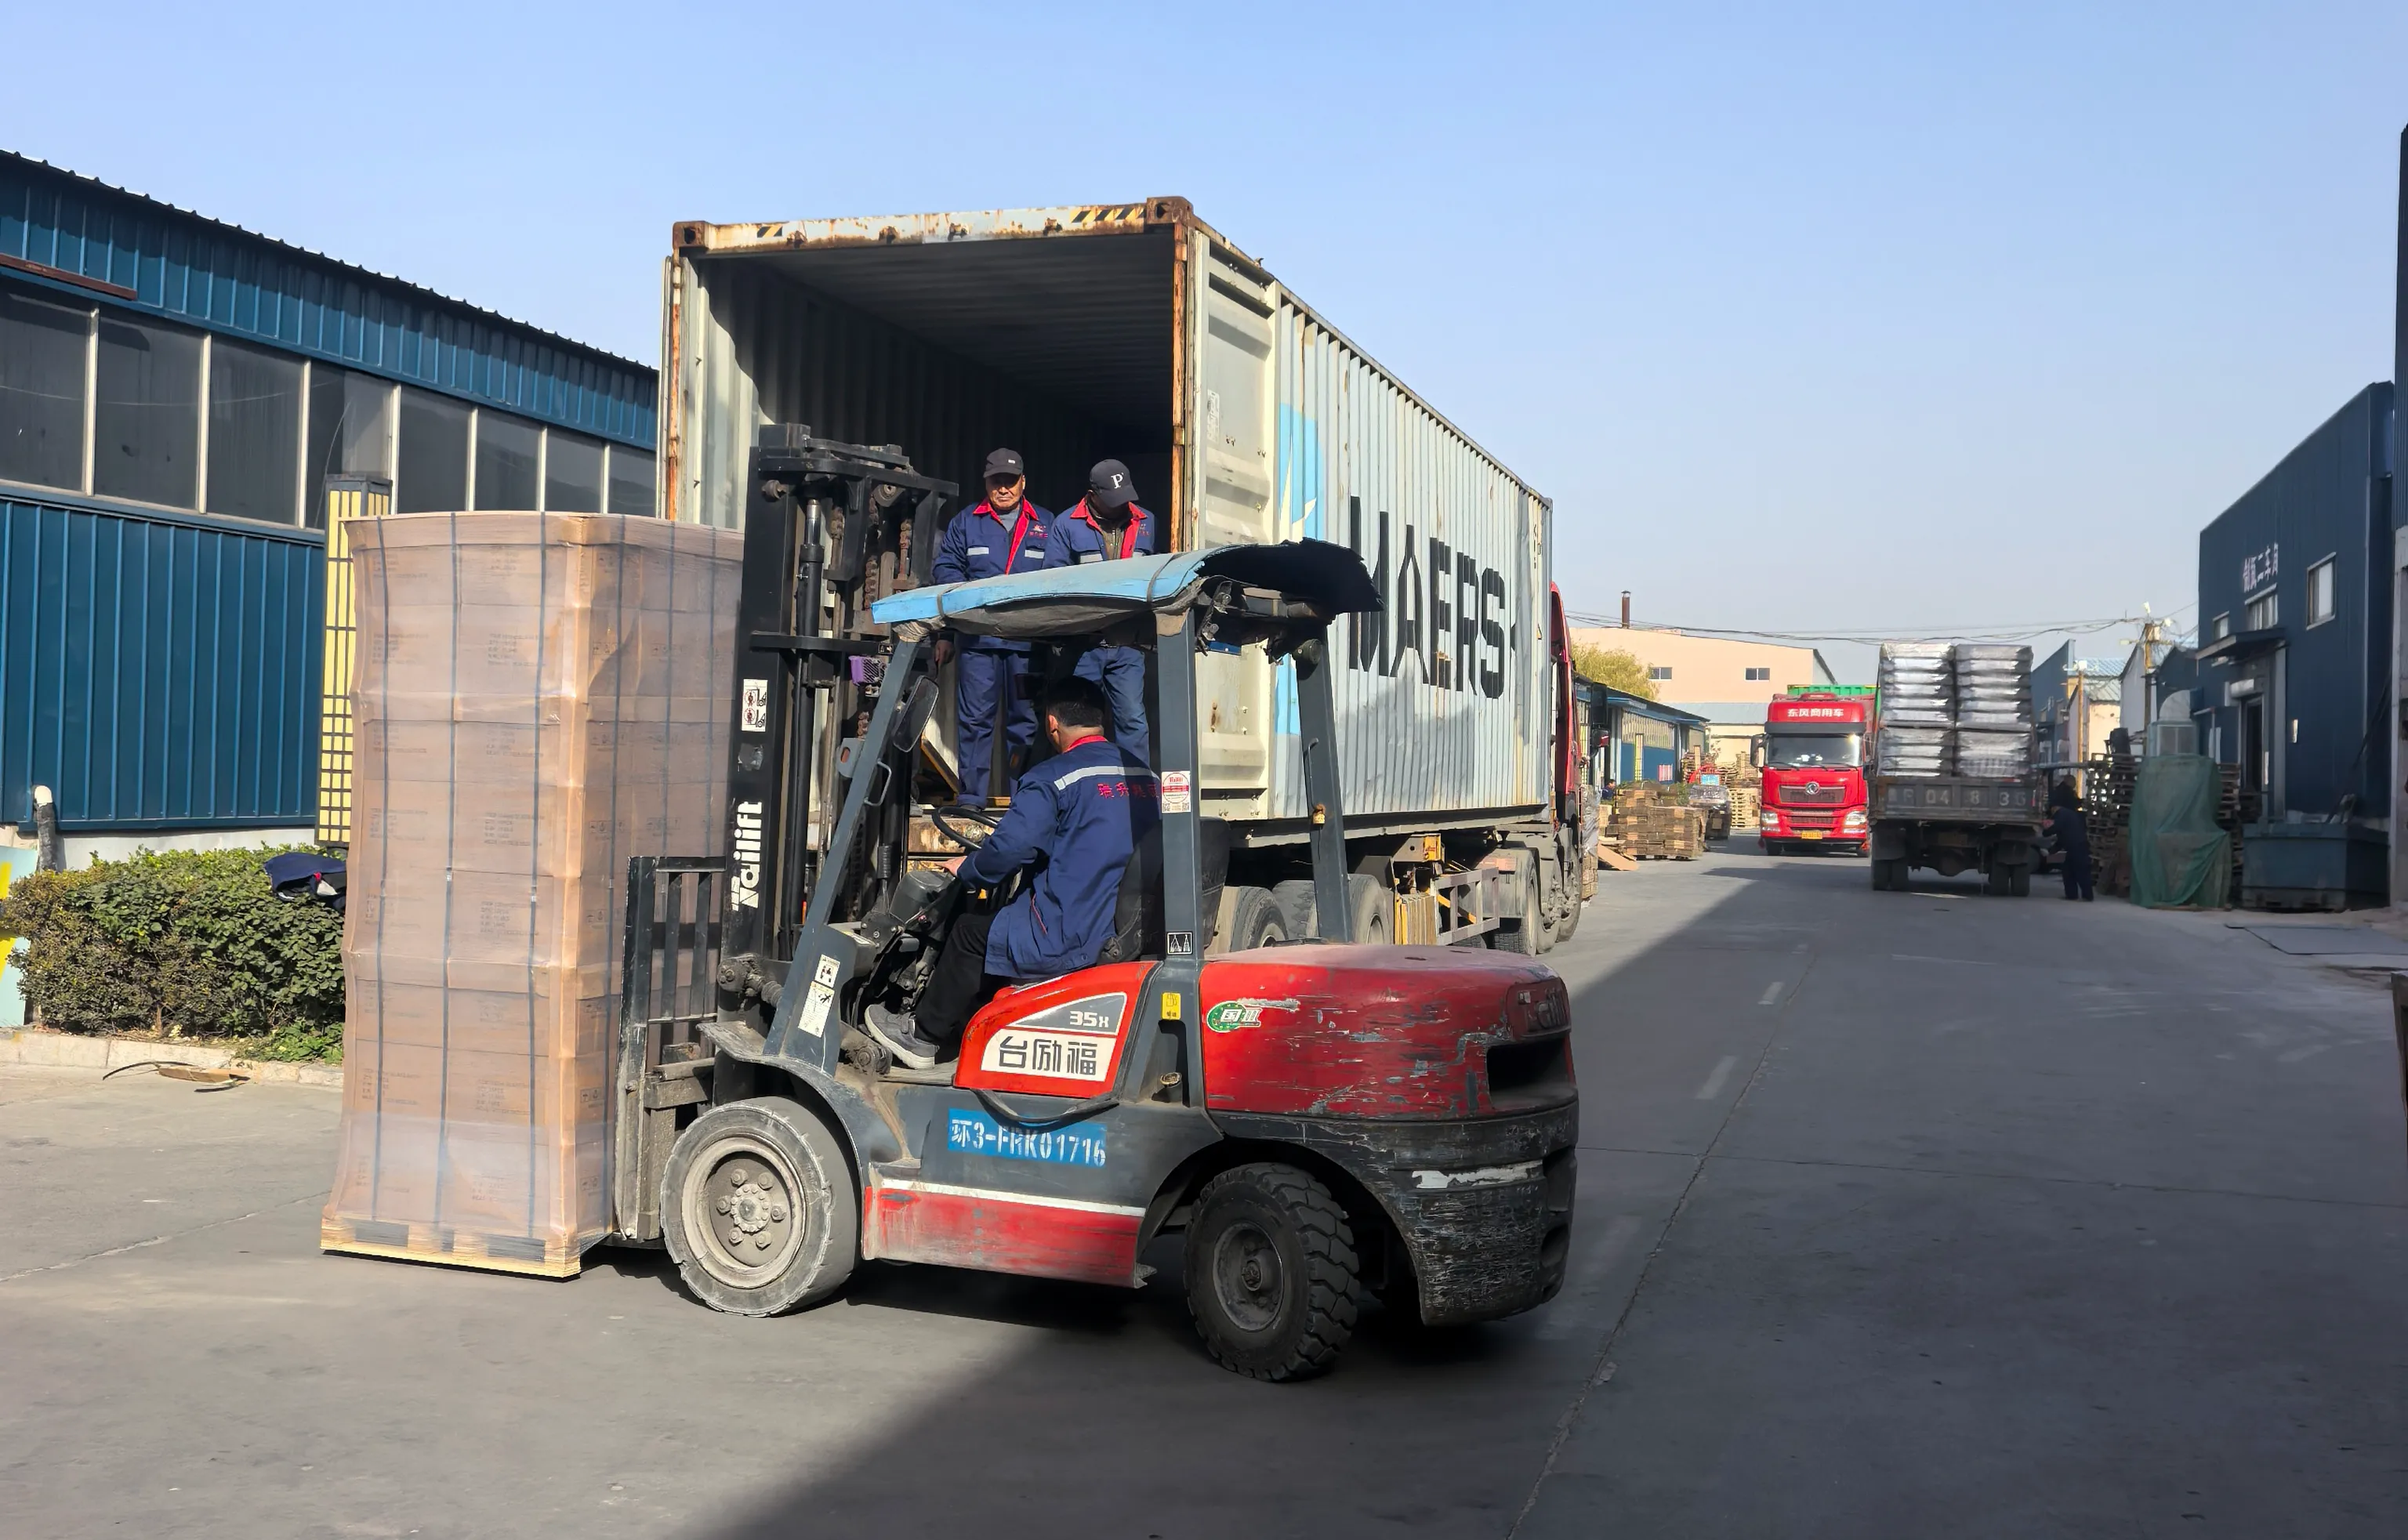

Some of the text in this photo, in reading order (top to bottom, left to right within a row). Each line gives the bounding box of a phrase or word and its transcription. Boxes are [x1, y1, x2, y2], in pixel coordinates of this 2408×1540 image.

[1349, 495, 1517, 700] MAERS
[1787, 708, 1844, 717] 东风商用车
[999, 1035, 1097, 1076] 台励福
